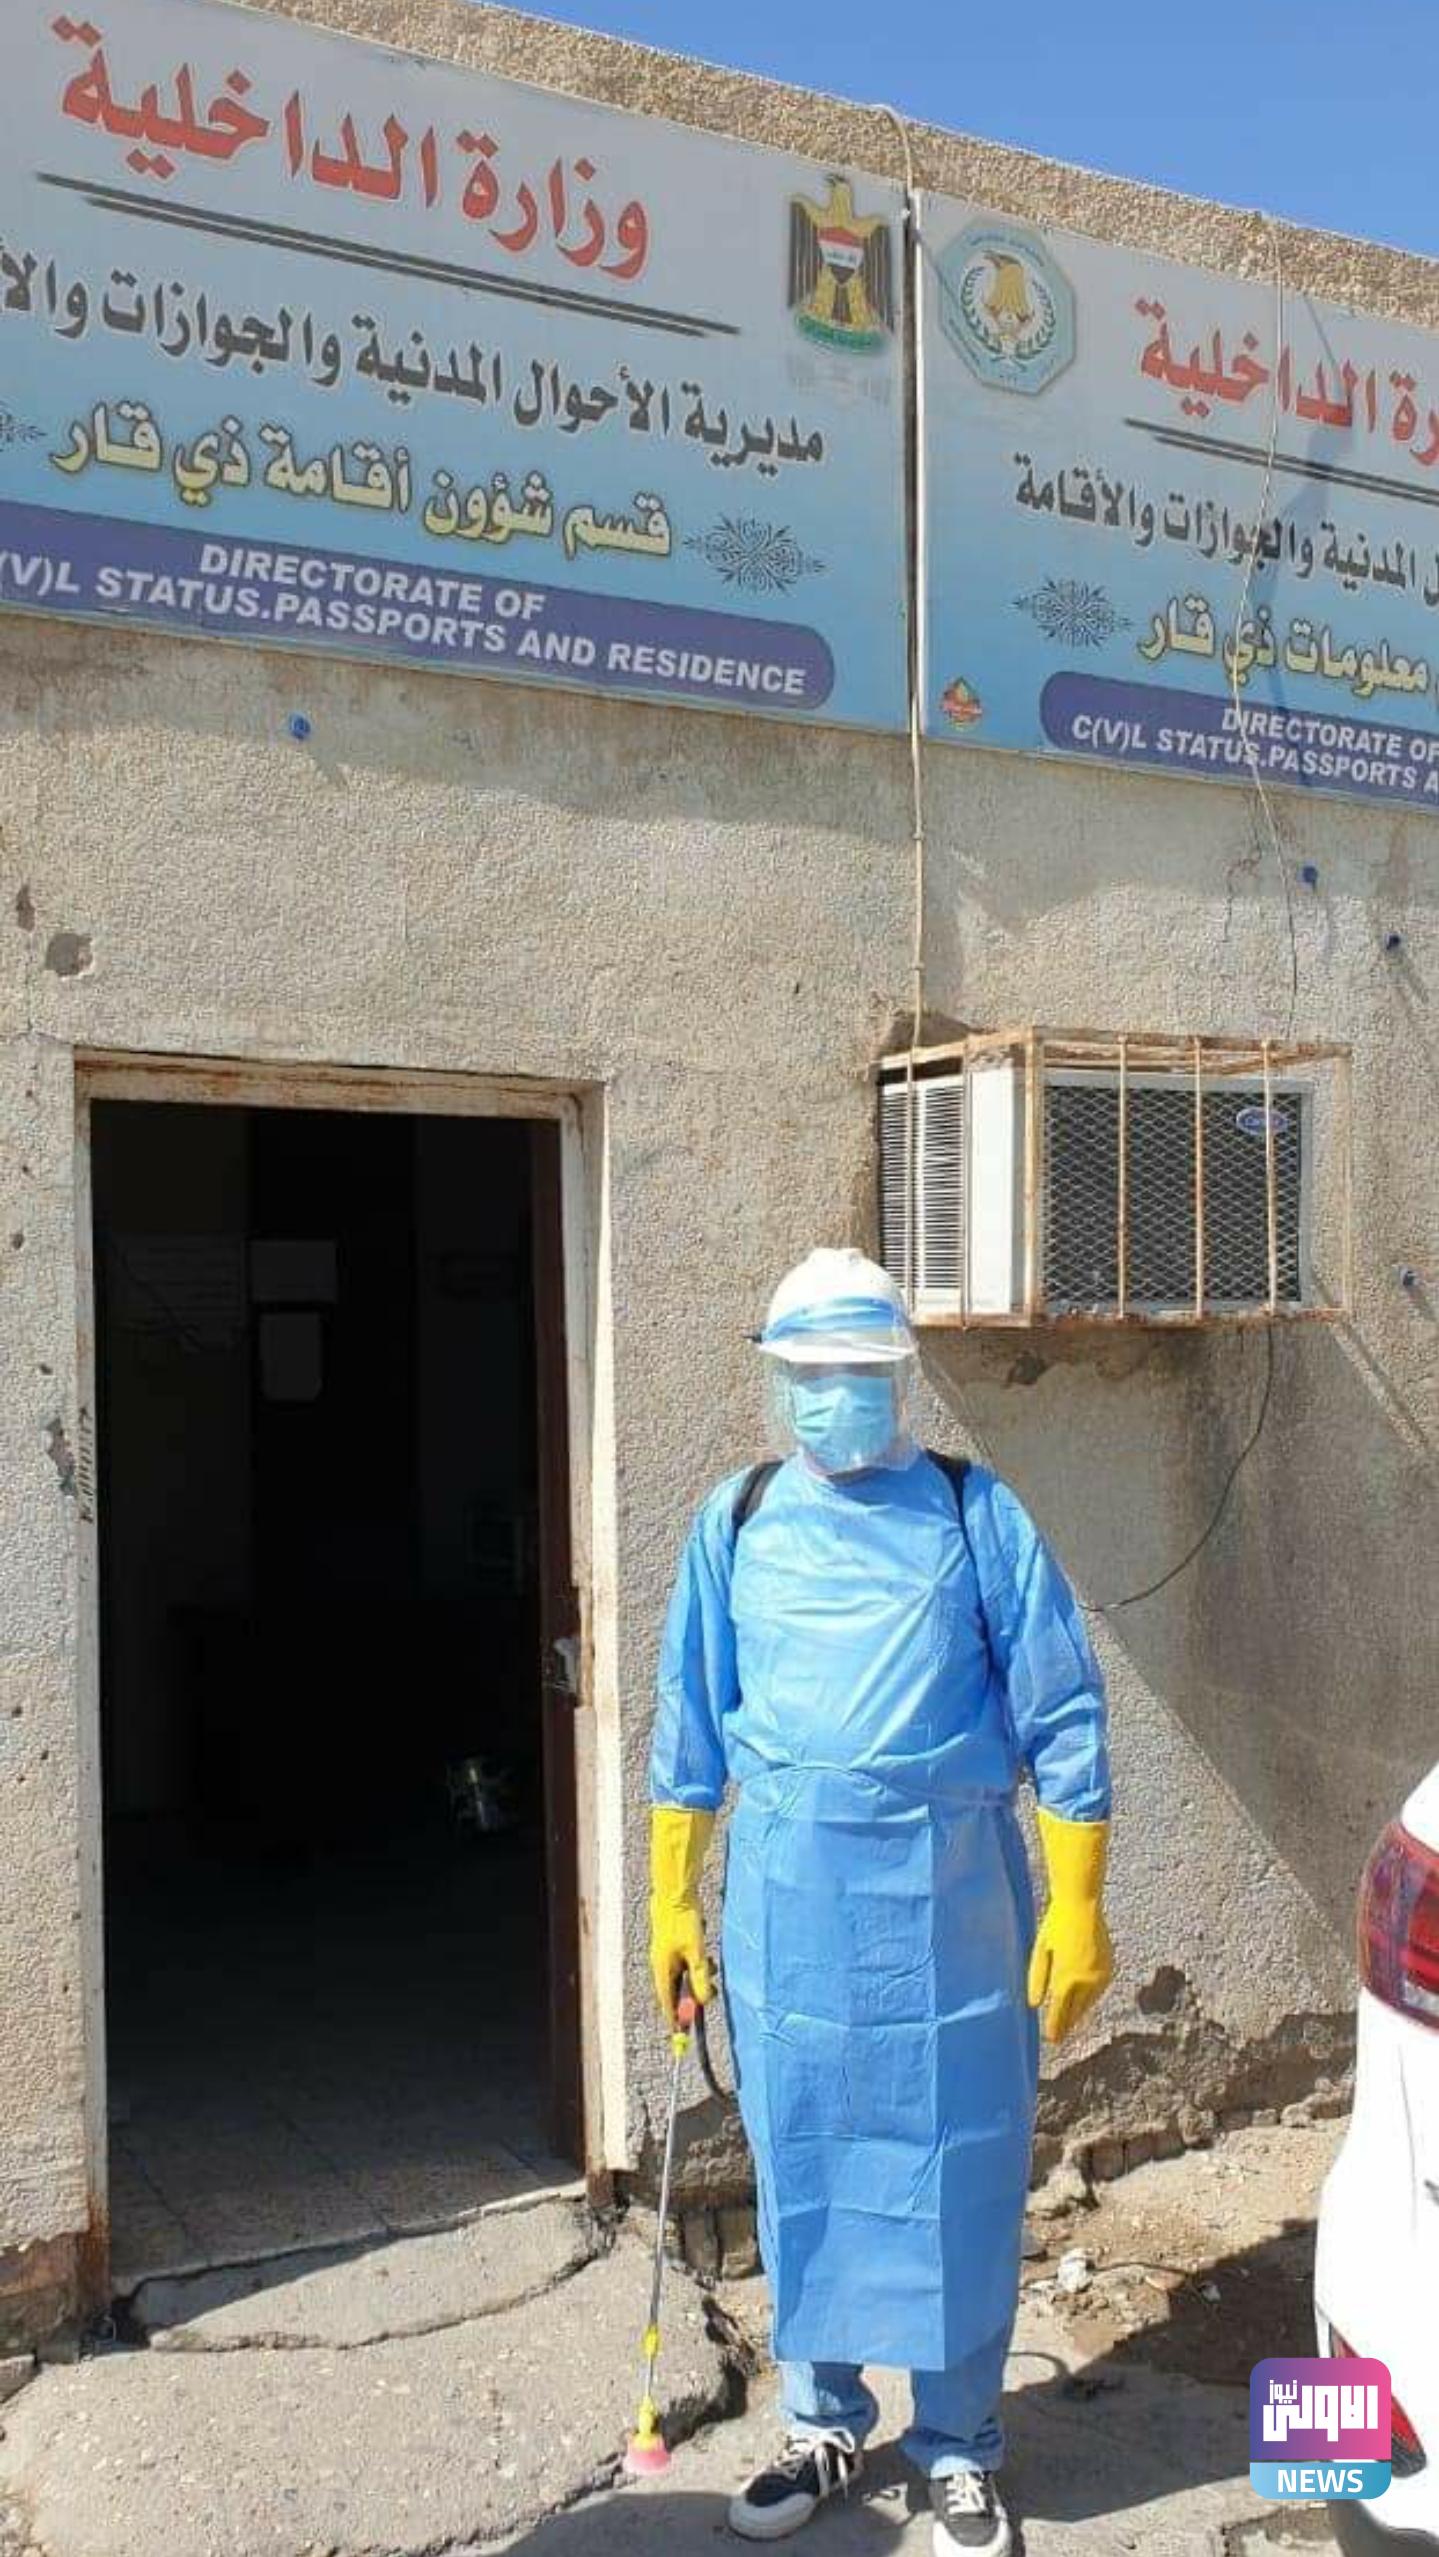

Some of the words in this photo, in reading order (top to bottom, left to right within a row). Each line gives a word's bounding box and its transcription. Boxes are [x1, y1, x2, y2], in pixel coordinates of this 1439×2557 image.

[51, 14, 440, 209] الداخلية
[456, 127, 650, 281] وزارة
[101, 267, 342, 388] والجوازات
[351, 313, 502, 405] المدنية
[1135, 298, 1379, 434] الداخلية
[49, 400, 164, 475] قار
[512, 360, 671, 436] الأحوال
[681, 379, 824, 477] مديرية
[174, 414, 252, 508] ذي
[423, 469, 554, 544] شؤون
[561, 491, 672, 561] قسم
[1164, 492, 1314, 580] والجوازات
[199, 542, 483, 616] DIRECTORATE
[494, 588, 547, 623] OF
[1322, 519, 1416, 591] المدنية
[95, 565, 507, 654] STATUS.PASSPORTS
[517, 627, 597, 668] AND
[607, 642, 807, 695] RESIDENCE
[1136, 593, 1217, 661] قار
[1222, 604, 1277, 688] ذي
[1283, 617, 1431, 698] معلومات
[1071, 713, 1147, 753] C(V)L
[1157, 728, 1418, 791] STATUS.PASSPORTS
[1221, 706, 1403, 758] DIRECTORATE
